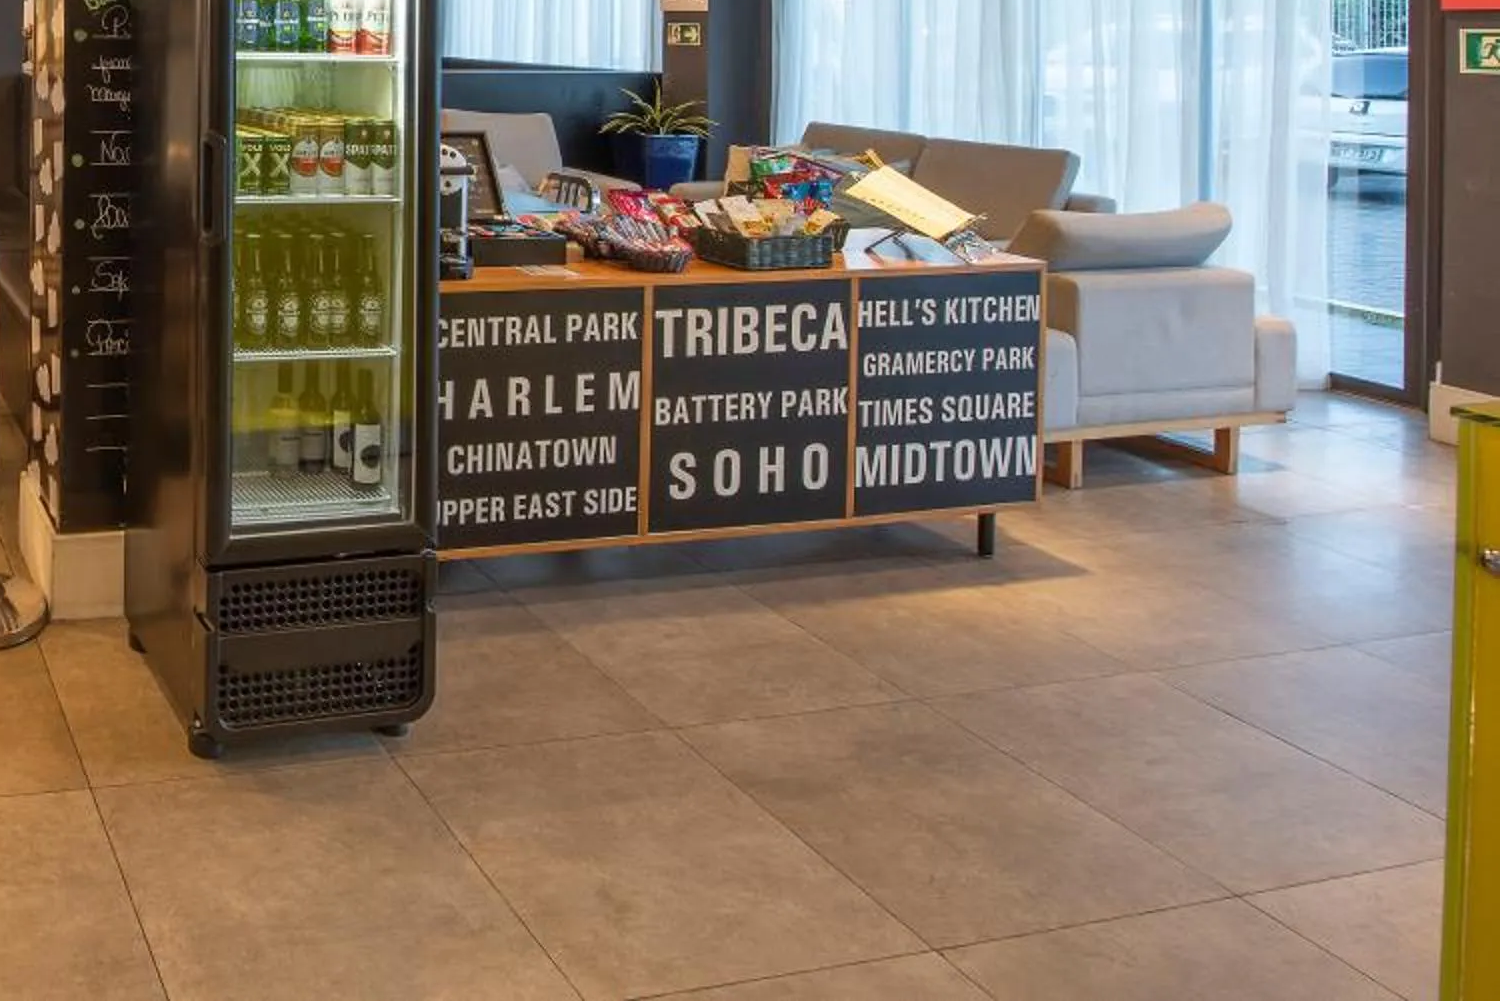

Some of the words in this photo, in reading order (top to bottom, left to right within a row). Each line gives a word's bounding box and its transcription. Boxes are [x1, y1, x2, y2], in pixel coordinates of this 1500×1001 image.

[438, 314, 557, 349] CENTRAL
[565, 311, 639, 342] PARK
[655, 302, 849, 358] TRIBECA
[858, 298, 937, 328] HELL'S
[944, 294, 1041, 325] KITCHEN
[863, 349, 975, 377] GRAMERCY
[982, 346, 1035, 370] PARK
[438, 371, 641, 420] HARLEM
[655, 390, 773, 426] BATTERY
[781, 387, 849, 418] PARK
[858, 397, 933, 427] TIMES
[941, 390, 1035, 423] SQUARE
[447, 435, 617, 476] CHINATOWN
[669, 442, 829, 499] SOHO
[855, 434, 1037, 488] MIDTOWN
[437, 496, 506, 526] PPER
[513, 491, 576, 520] EAST
[583, 487, 638, 516] SIDE
